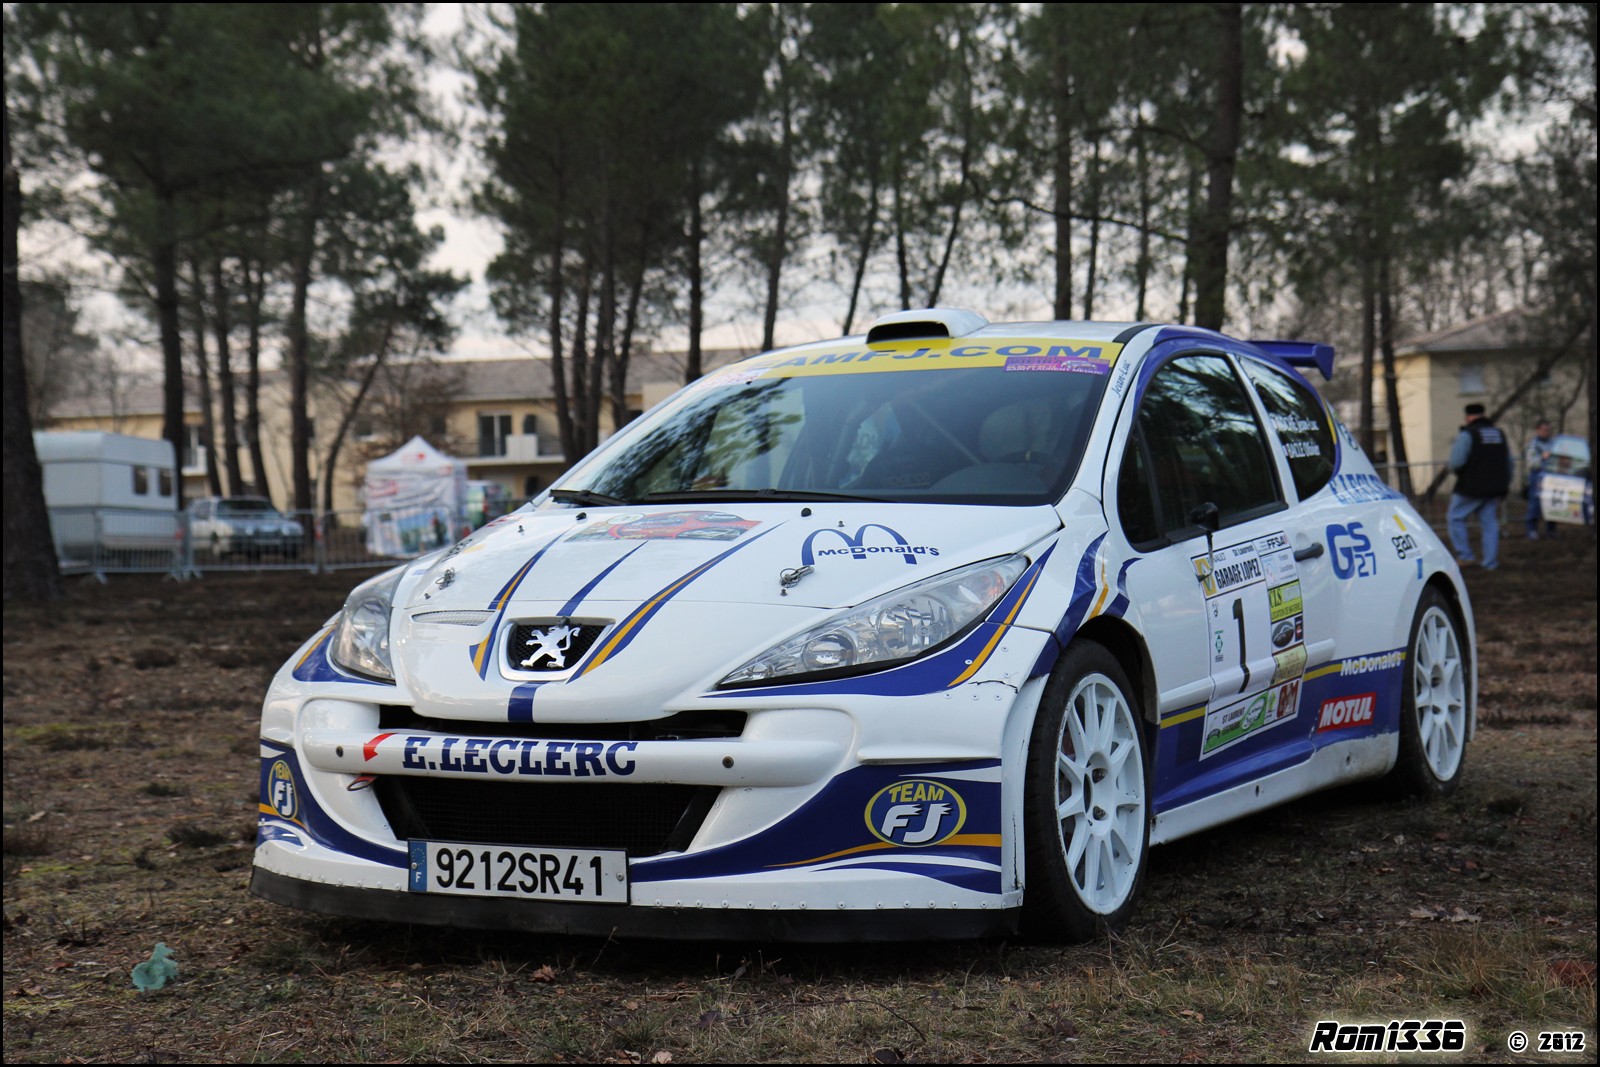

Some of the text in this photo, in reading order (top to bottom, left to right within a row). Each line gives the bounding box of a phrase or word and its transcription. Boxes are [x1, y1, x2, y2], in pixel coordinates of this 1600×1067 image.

[818, 545, 940, 557] McDonald's
[1266, 536, 1286, 550] FFSA
[1391, 533, 1418, 560] gan
[1214, 558, 1262, 589] GARAGE LOPEZ
[1354, 552, 1376, 578] 27
[1232, 598, 1250, 694] 1
[1319, 696, 1373, 729] MOTUL
[402, 736, 639, 777] E.LECLERC
[273, 780, 293, 816] FJ
[888, 783, 945, 803] TEAM
[881, 803, 953, 843] FJ
[415, 872, 422, 883] F
[436, 847, 603, 896] 9212SR41
